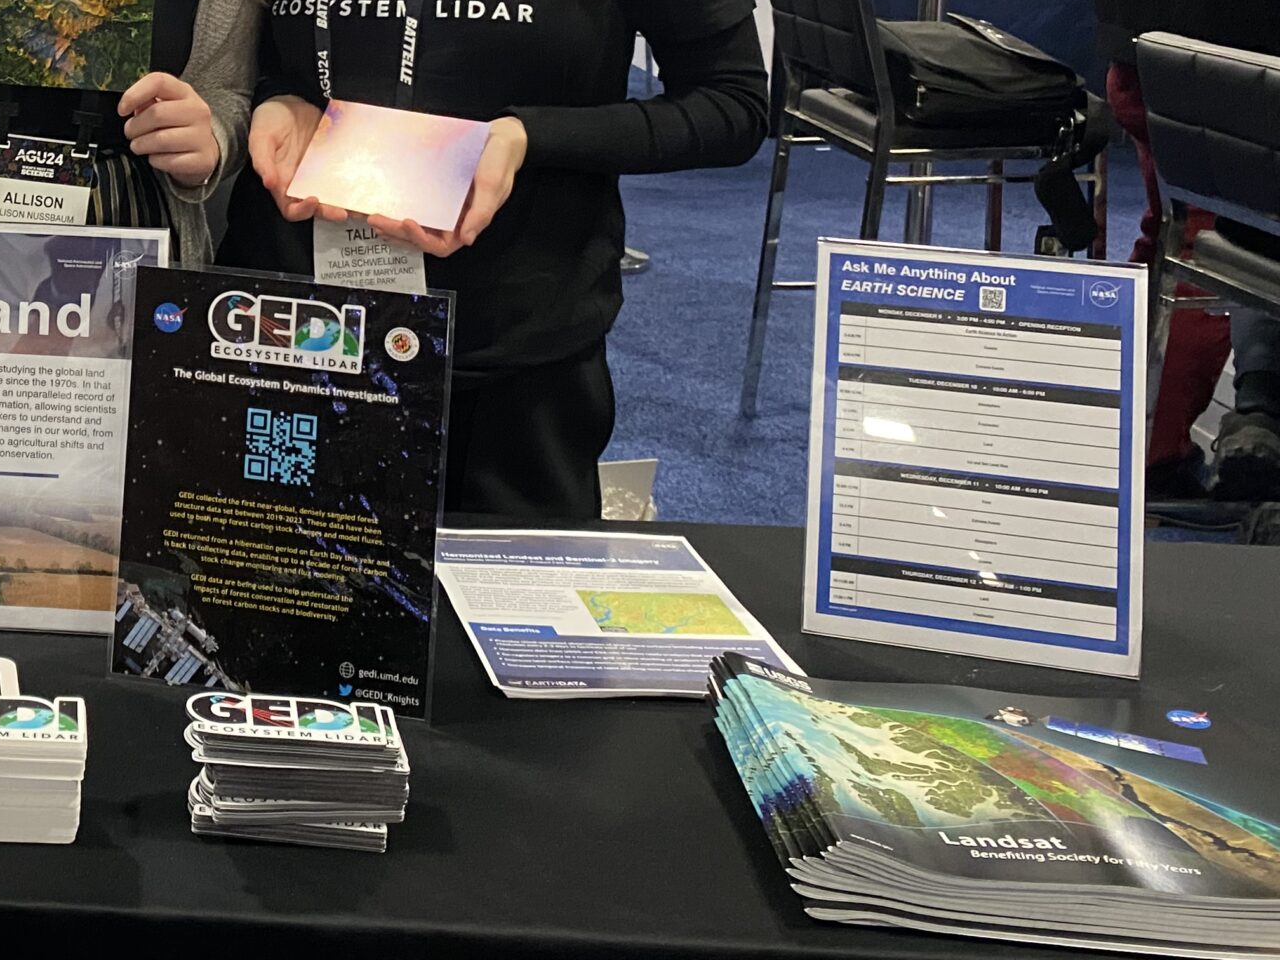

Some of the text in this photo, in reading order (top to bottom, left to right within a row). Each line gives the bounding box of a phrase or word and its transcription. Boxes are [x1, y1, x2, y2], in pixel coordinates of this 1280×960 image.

[436, 0, 534, 23] LIDAR
[400, 16, 418, 85] BATTELLE
[317, 50, 331, 99] AGU24
[15, 149, 64, 166] AGU24
[3, 192, 64, 209] ALLISON
[27, 212, 74, 223] NUSSBAUM
[346, 228, 379, 241] TALI
[340, 244, 391, 258] (SHE/HER)
[328, 256, 408, 269] TALIA SCHWELLING
[321, 270, 363, 280] UNIVERSITY
[842, 260, 1016, 286] Ask Me Anything About
[841, 280, 965, 301] EARTH SCIENCE
[1091, 291, 1117, 300] NASA
[156, 313, 181, 322] NASA
[209, 292, 365, 357] GEDI
[214, 345, 358, 371] ECOSYSTEM LIDAR
[39, 366, 52, 375] the
[55, 367, 83, 378] global
[85, 368, 104, 378] land
[6, 376, 29, 386] since
[32, 377, 46, 387] the
[83, 380, 91, 389] In
[94, 380, 111, 390] that
[173, 368, 399, 405] The Global Ecosystem Dynamics Investigation
[16, 390, 72, 400] unparalleled
[75, 392, 103, 401] record
[106, 393, 115, 402] of
[35, 402, 71, 414] allowing
[74, 404, 117, 414] scientists
[19, 412, 28, 421] to
[31, 413, 81, 424] understand
[85, 416, 102, 425] and
[34, 425, 42, 434] in
[45, 427, 60, 435] our
[63, 427, 90, 437] world,
[93, 427, 113, 437] from
[8, 438, 57, 449] agricultural
[60, 439, 84, 449] shifts
[87, 441, 104, 450] and
[440, 552, 501, 560] Harmonized
[202, 596, 338, 622] on forest carbon stocks and biodiversity.
[502, 626, 541, 635] Benefits
[359, 669, 419, 685] gedi.umd.edu
[524, 679, 587, 687] EARTHDATA
[763, 667, 811, 690] USGS
[355, 689, 419, 706] @GEDI_Knights
[190, 693, 381, 734] GEDI
[22, 732, 78, 740] LIDAR
[198, 723, 382, 743] ECOSYSTEM LIDAR
[938, 831, 1067, 851] Landsat
[970, 849, 1045, 862] Benefiting
[1047, 852, 1101, 865] Society
[1103, 854, 1124, 865] for
[1160, 864, 1201, 876] Years
